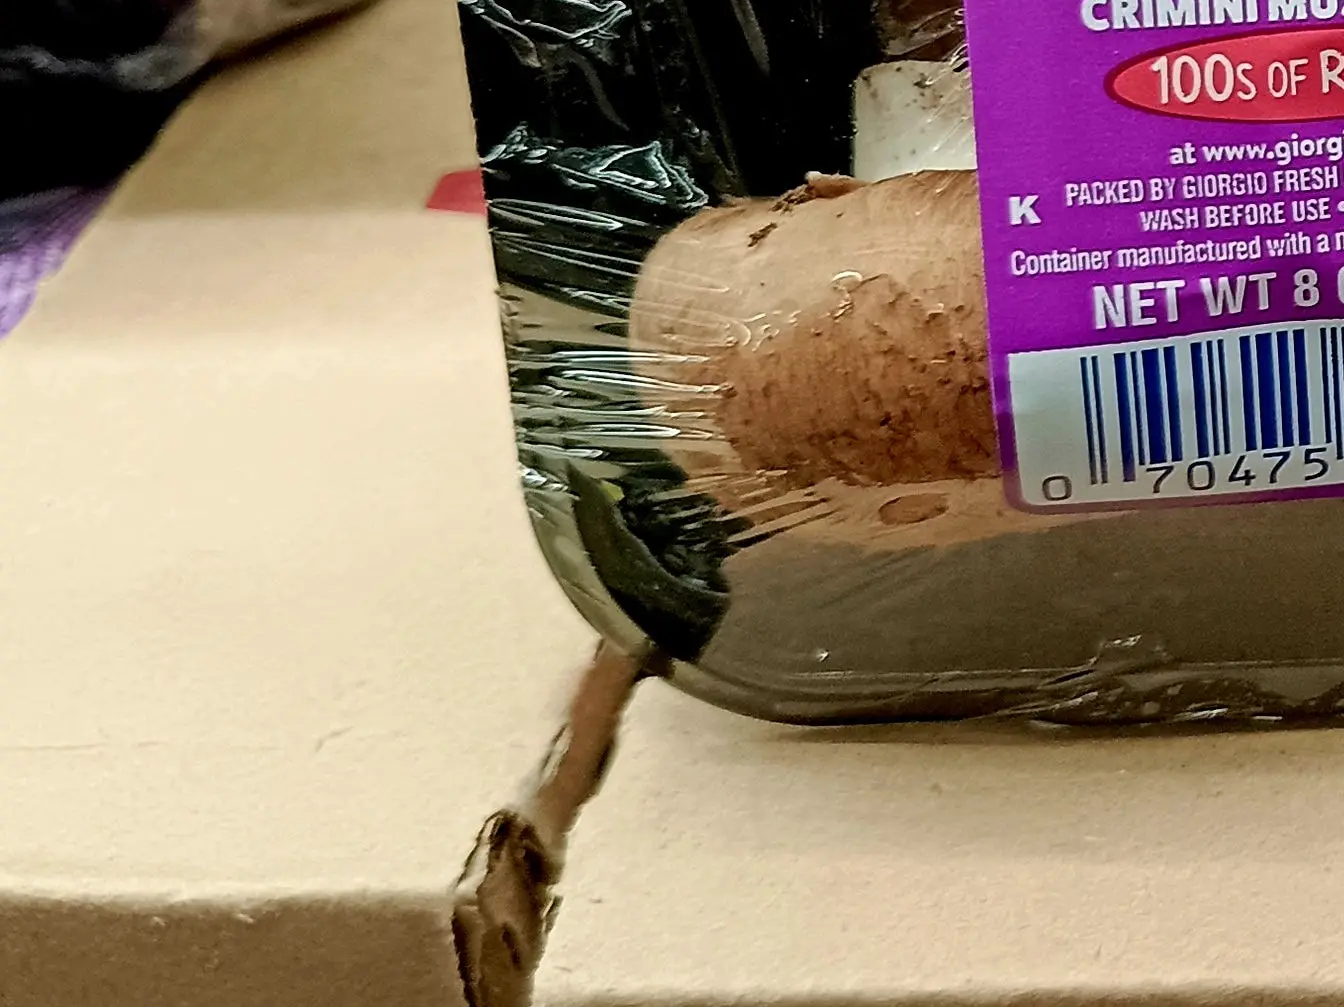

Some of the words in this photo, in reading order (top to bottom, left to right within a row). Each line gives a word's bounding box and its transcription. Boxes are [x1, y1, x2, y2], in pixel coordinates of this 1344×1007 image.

[1169, 143, 1197, 165] at
[1066, 179, 1144, 206] PACKED
[1149, 177, 1176, 200] BY
[1182, 171, 1267, 199] GIORGIO
[1273, 165, 1338, 193] FRESH
[1009, 194, 1041, 225] K
[1139, 207, 1199, 231] WASH
[1205, 202, 1285, 228] BEFORE
[1292, 197, 1331, 221] USE
[1011, 249, 1112, 276] Container
[1117, 240, 1262, 268] manufactured
[1266, 231, 1312, 257] with
[1318, 238, 1331, 253] a
[1093, 279, 1186, 330] NET
[1200, 272, 1277, 317] WT
[1293, 268, 1320, 307] 8
[1042, 475, 1072, 501] 0
[1146, 446, 1330, 495] 70475
